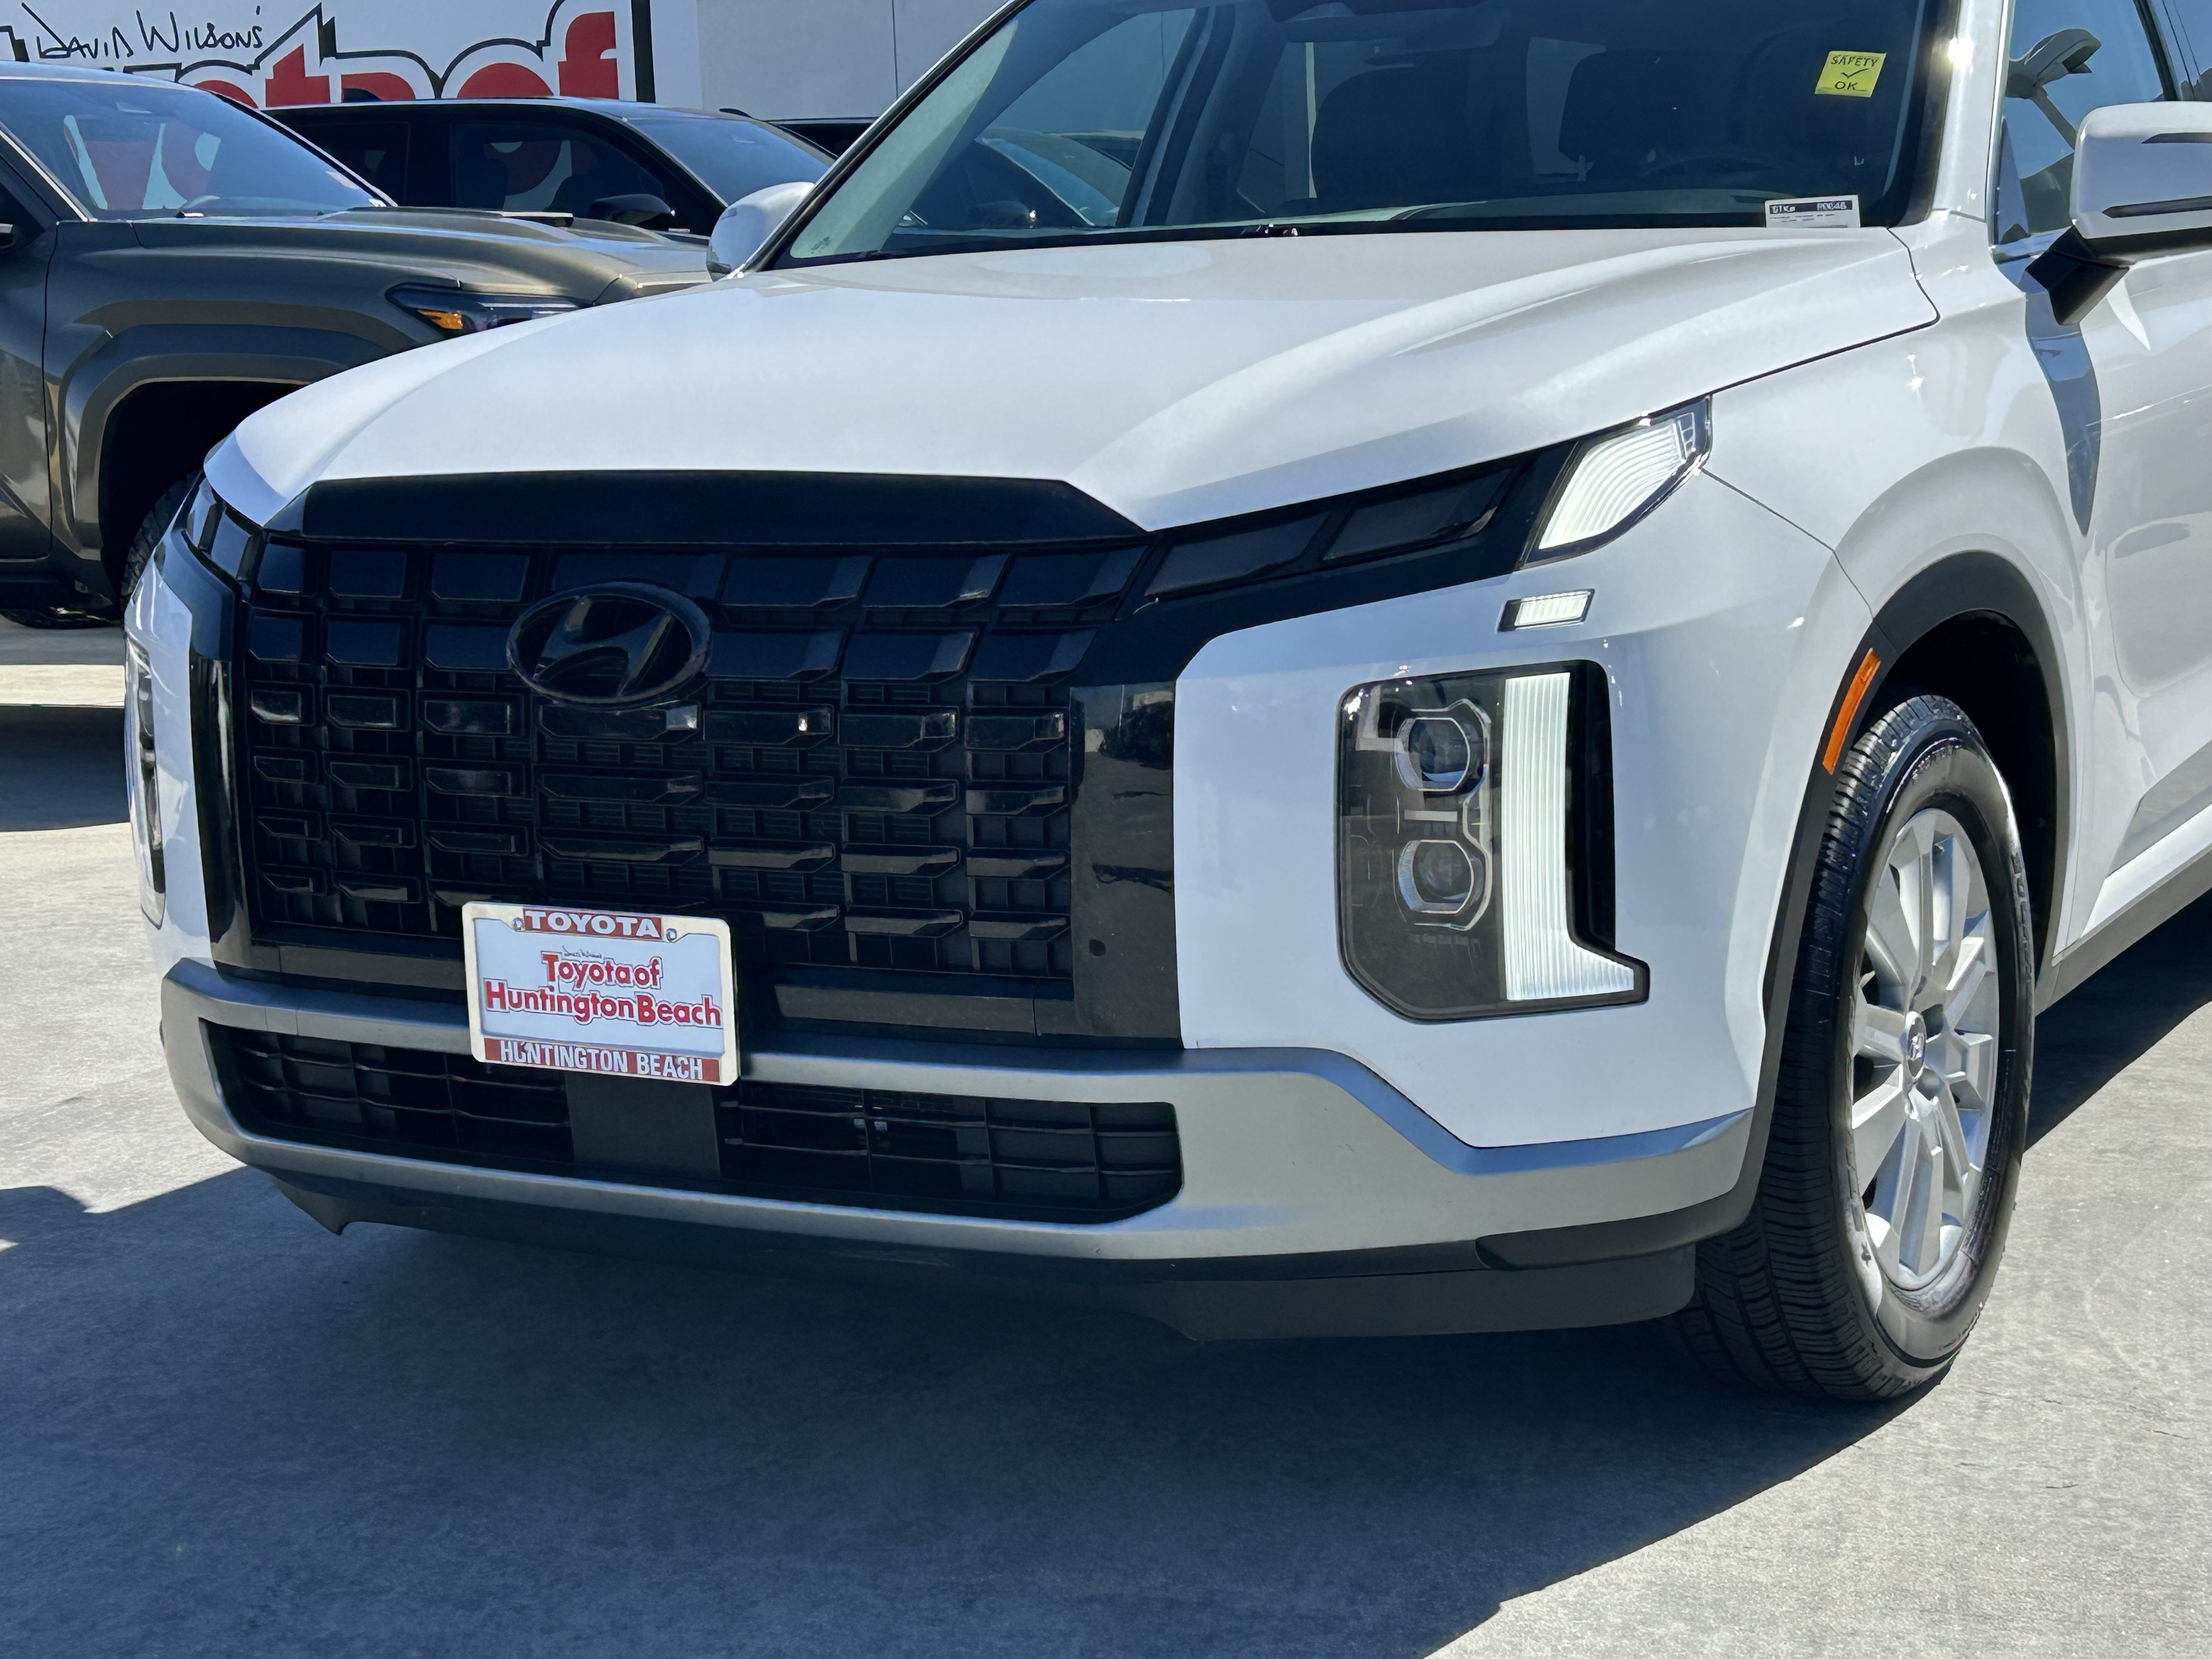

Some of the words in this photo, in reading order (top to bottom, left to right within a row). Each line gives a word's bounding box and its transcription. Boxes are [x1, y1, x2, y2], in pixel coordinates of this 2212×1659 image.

[1830, 55, 1880, 67] SAFETY
[1834, 81, 1858, 91] OK
[525, 911, 662, 938] TOYOTA
[541, 953, 631, 989] Toyota
[634, 958, 661, 986] of
[500, 1039, 629, 1073] HUNTINGTON
[636, 1052, 703, 1081] BEACH
